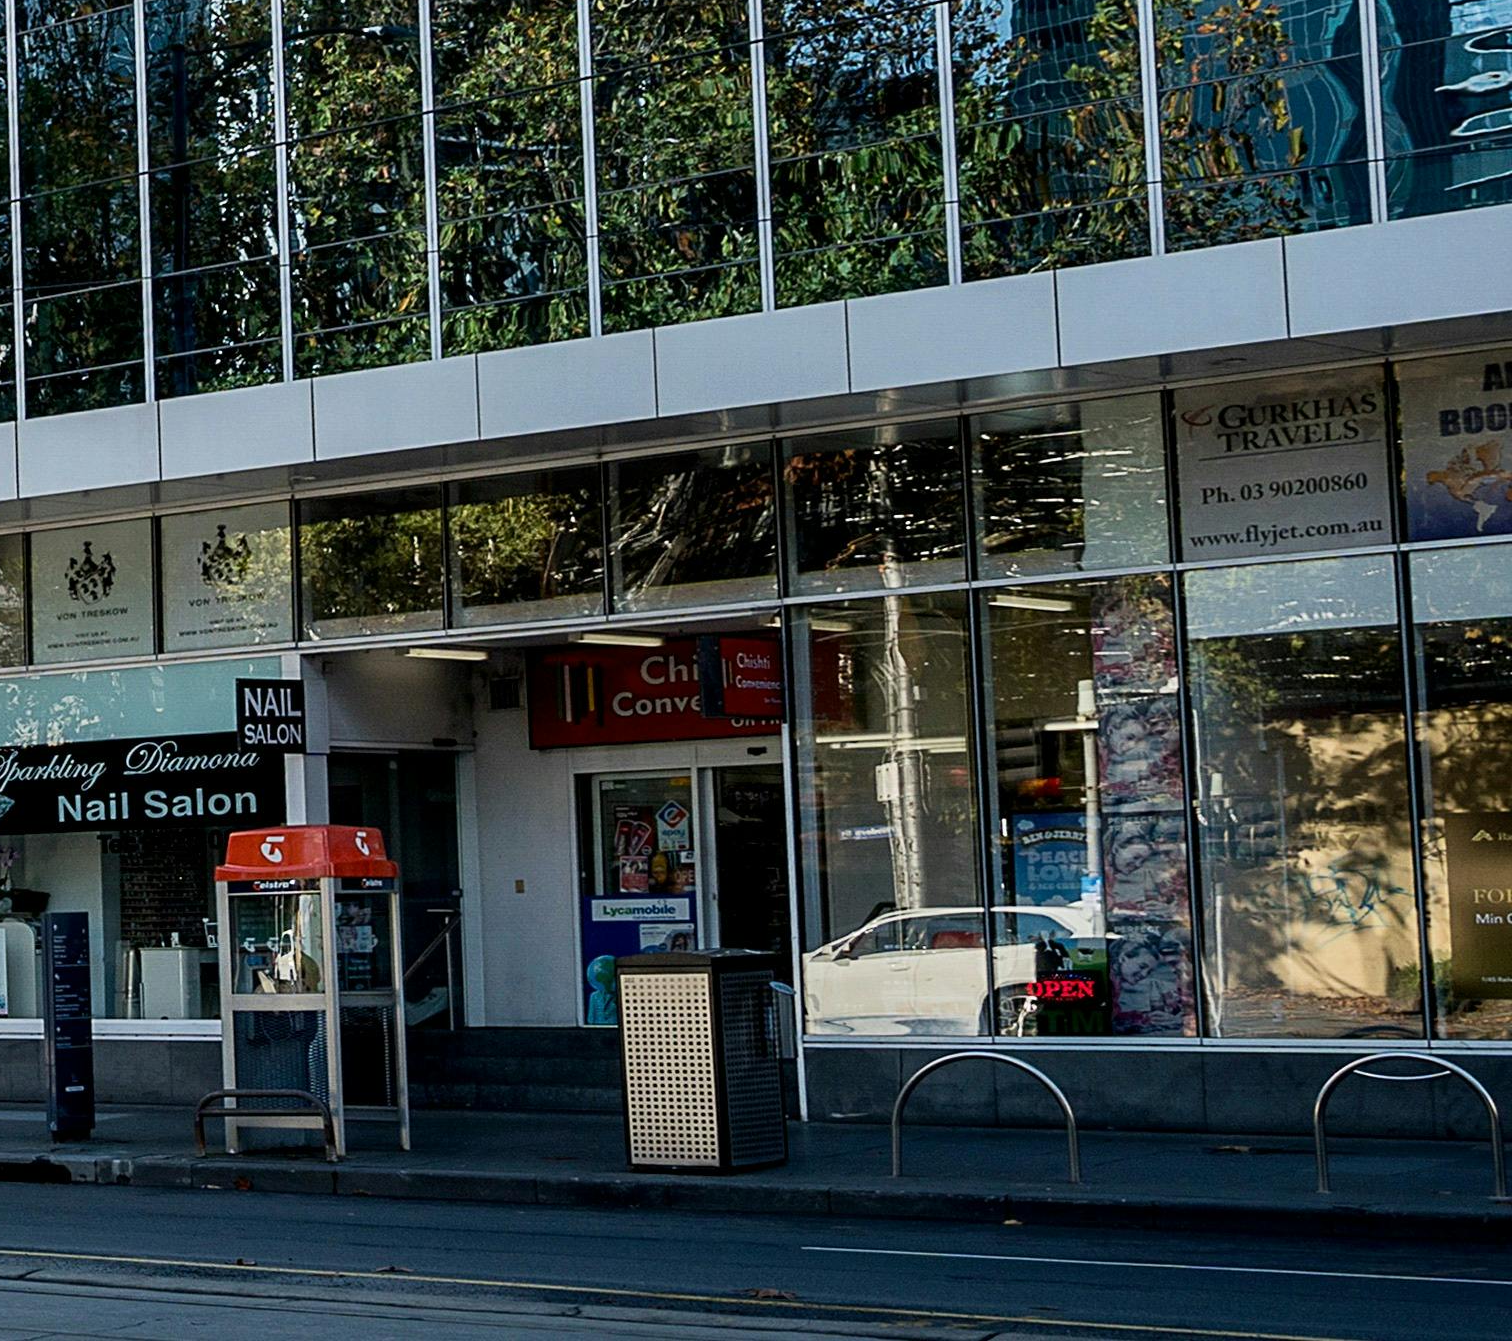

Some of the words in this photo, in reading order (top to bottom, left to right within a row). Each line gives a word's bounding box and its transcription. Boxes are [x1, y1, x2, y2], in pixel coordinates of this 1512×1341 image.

[1218, 392, 1378, 430] GURKHAS
[1438, 402, 1512, 437] BOO
[1218, 418, 1360, 453] TRAVELS
[1201, 486, 1236, 505] Ph.
[1240, 483, 1264, 501] 03
[1269, 472, 1368, 498] 90200860
[1190, 519, 1383, 548] www.flyjet.com.au
[244, 688, 302, 717] NAIL
[244, 723, 302, 744] SALON
[57, 791, 130, 823] Nail
[144, 788, 258, 819] Salon
[1028, 864, 1080, 881] LOV
[603, 904, 677, 917] Lycamobile
[1475, 913, 1503, 924] Min
[1025, 980, 1096, 999] OPEN
